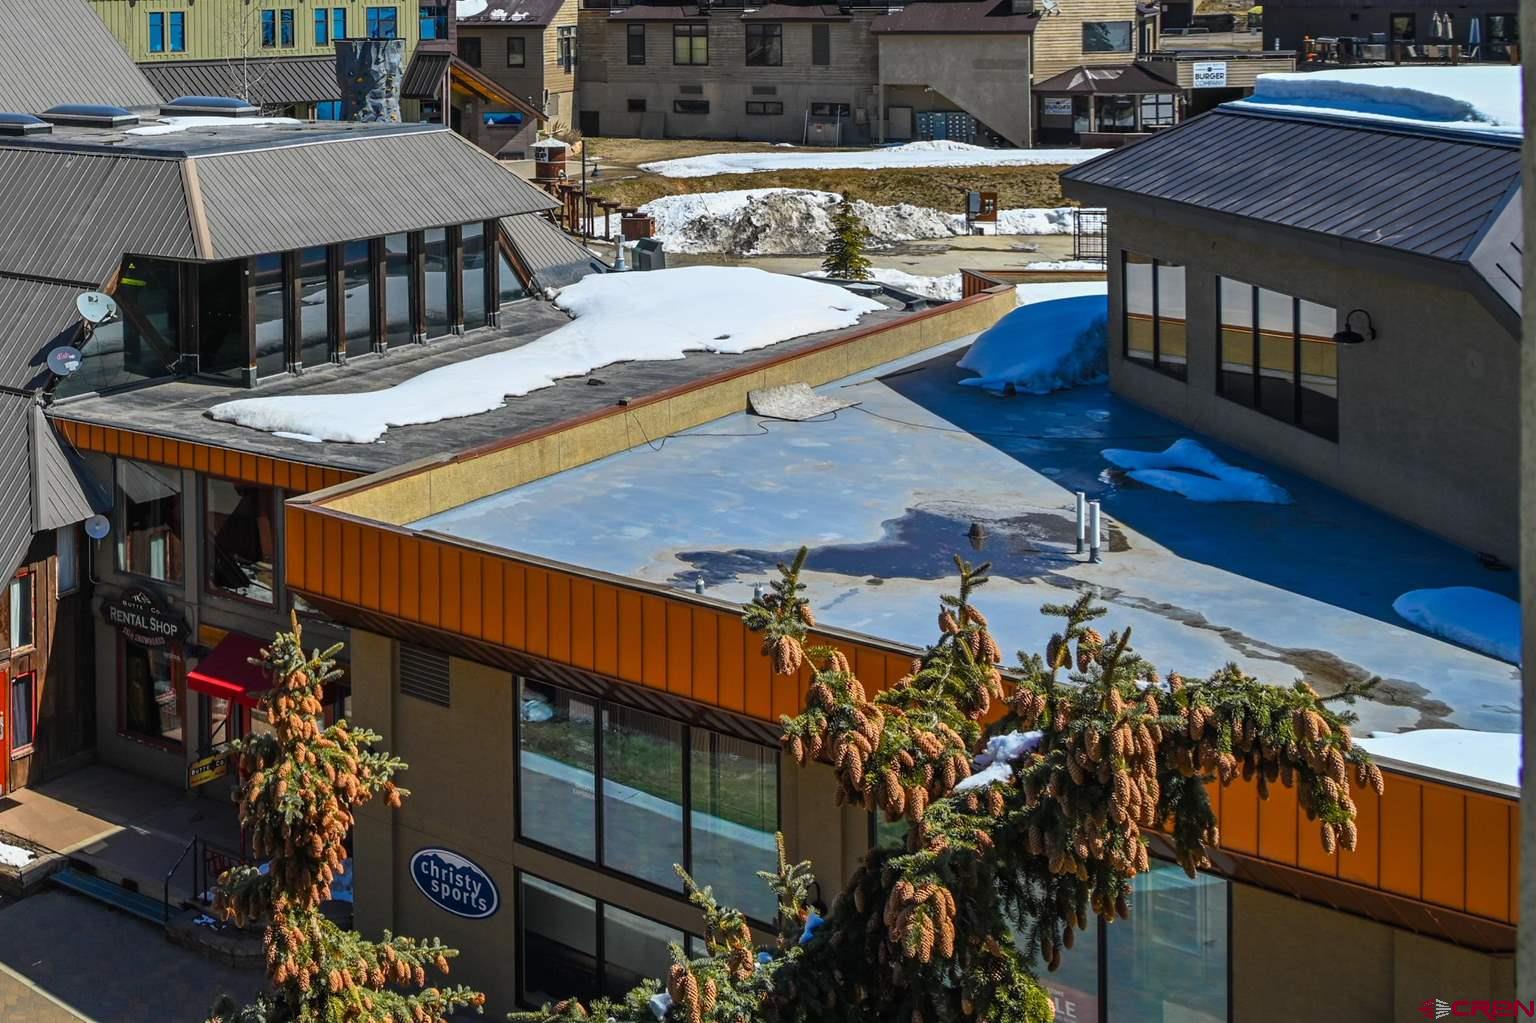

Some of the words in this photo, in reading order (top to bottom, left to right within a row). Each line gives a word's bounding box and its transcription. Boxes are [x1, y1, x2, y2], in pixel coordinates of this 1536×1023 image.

[109, 606, 149, 629] RENTAL
[150, 617, 178, 636] SHOP
[421, 860, 482, 899] christy
[431, 879, 487, 912] sports
